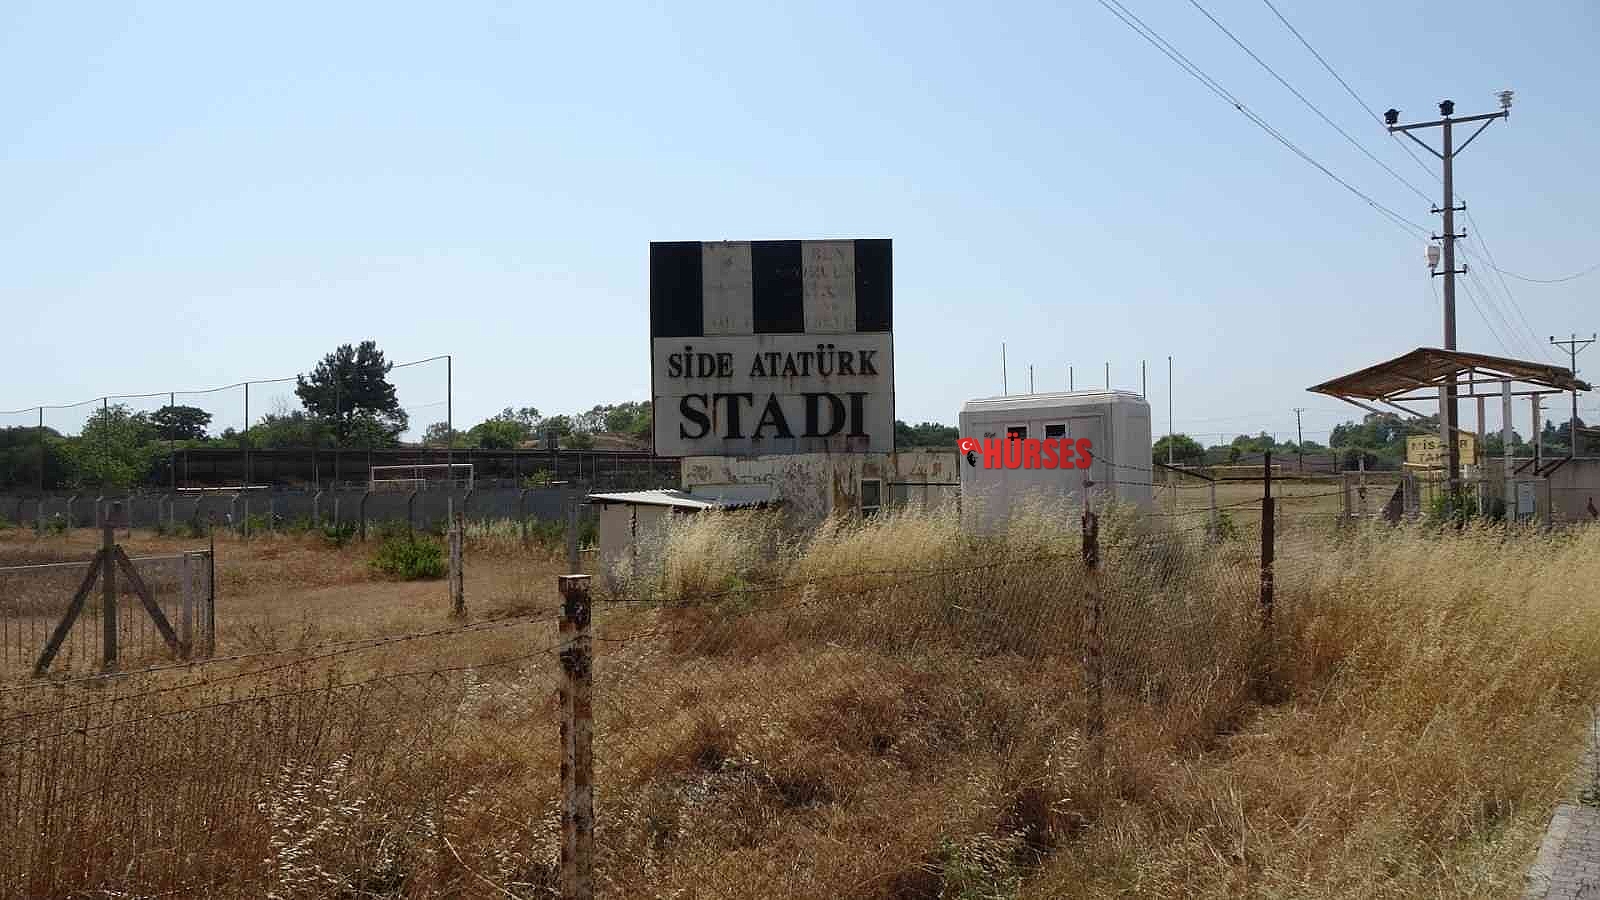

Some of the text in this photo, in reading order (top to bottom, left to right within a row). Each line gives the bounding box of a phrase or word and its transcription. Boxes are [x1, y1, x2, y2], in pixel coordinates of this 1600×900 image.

[668, 343, 879, 378] SİDE ATATÜRK
[679, 392, 871, 440] STADI
